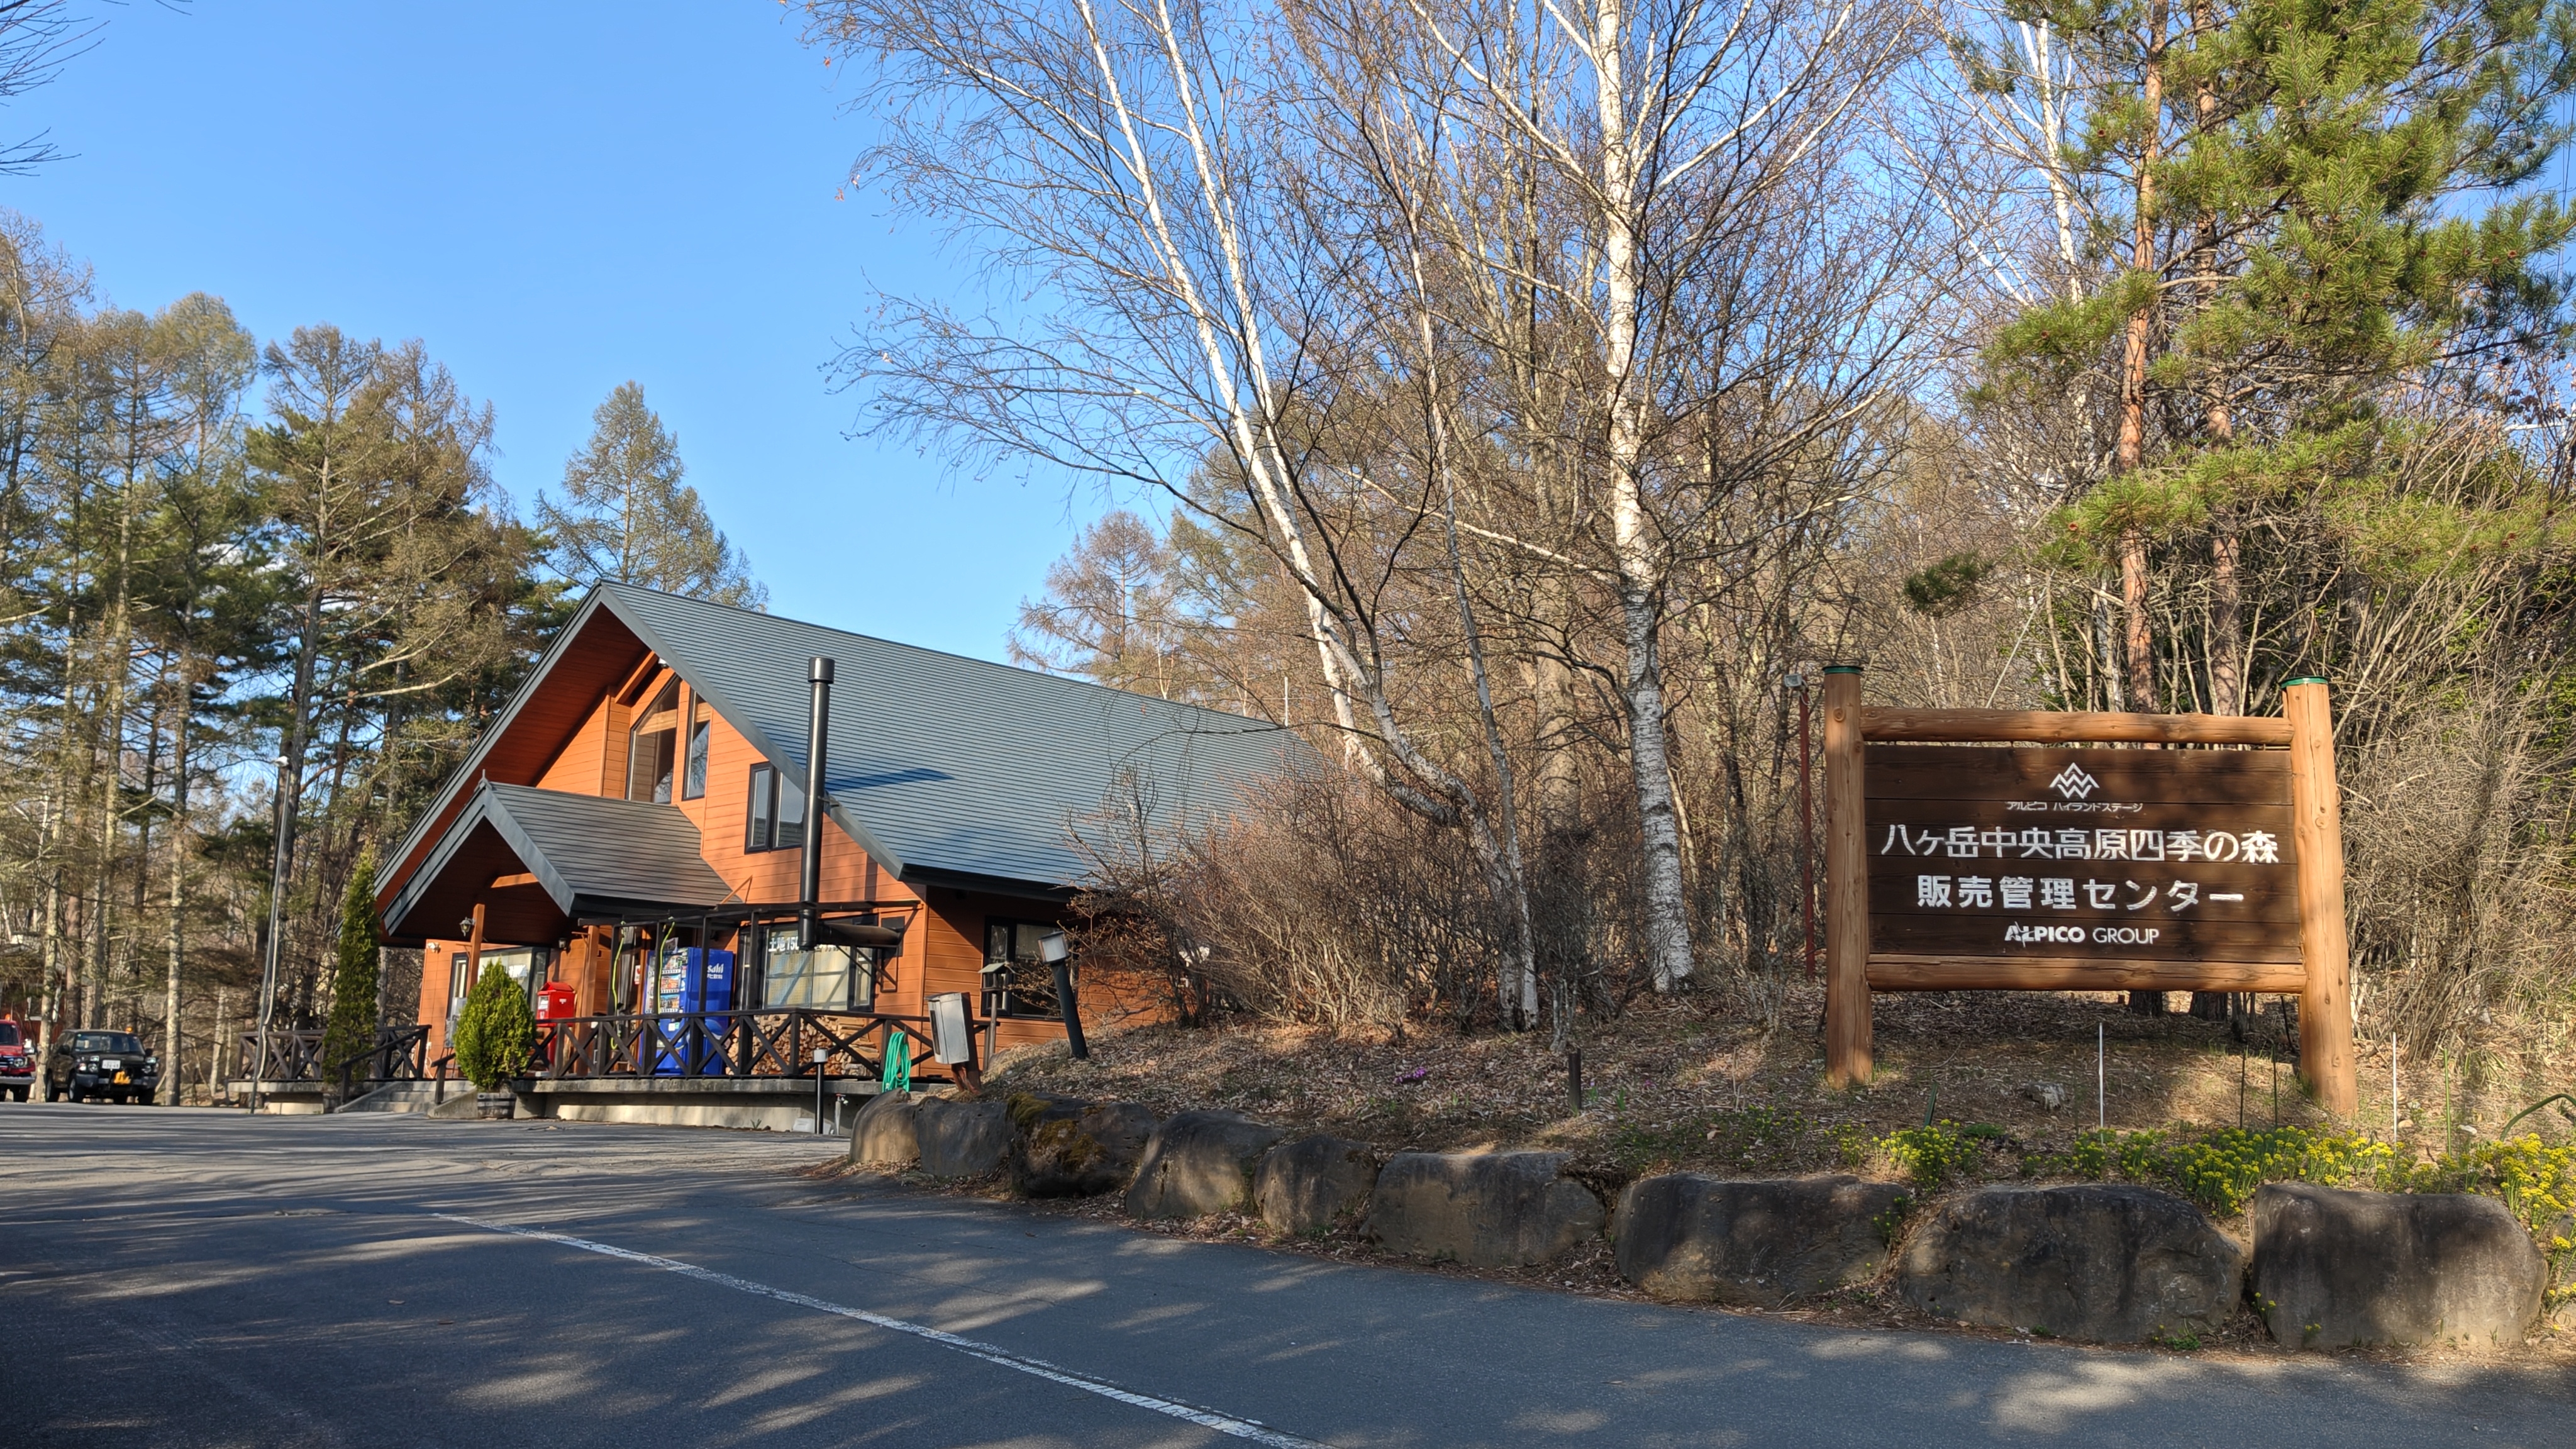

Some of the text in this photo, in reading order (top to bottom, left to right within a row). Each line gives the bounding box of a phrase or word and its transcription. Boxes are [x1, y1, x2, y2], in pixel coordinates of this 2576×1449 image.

[2006, 801, 2143, 813] アルピコ ハイランドステージ
[1917, 875, 2244, 912] 販売管理センター
[2004, 921, 2160, 948] ALPICO GROUP
